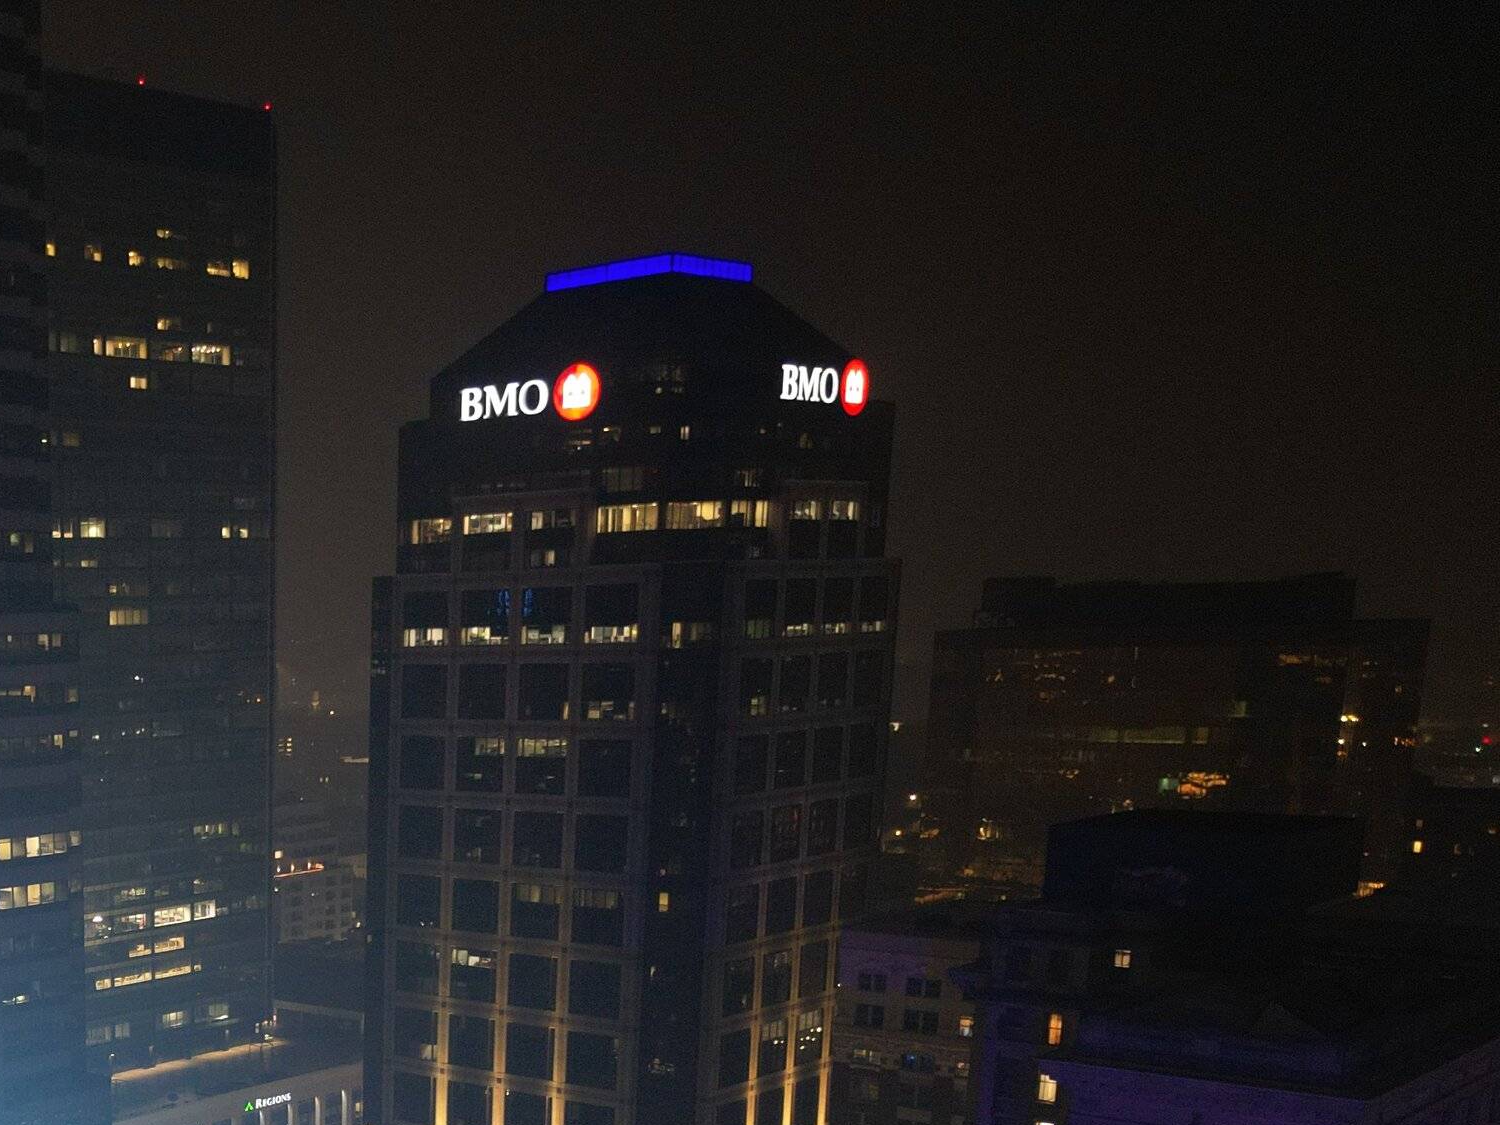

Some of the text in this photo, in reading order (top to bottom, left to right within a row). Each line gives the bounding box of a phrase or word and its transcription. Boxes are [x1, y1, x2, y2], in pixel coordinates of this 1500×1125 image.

[459, 379, 549, 421] BMO
[779, 364, 838, 404] BMO
[255, 1092, 292, 1110] REGIONS
